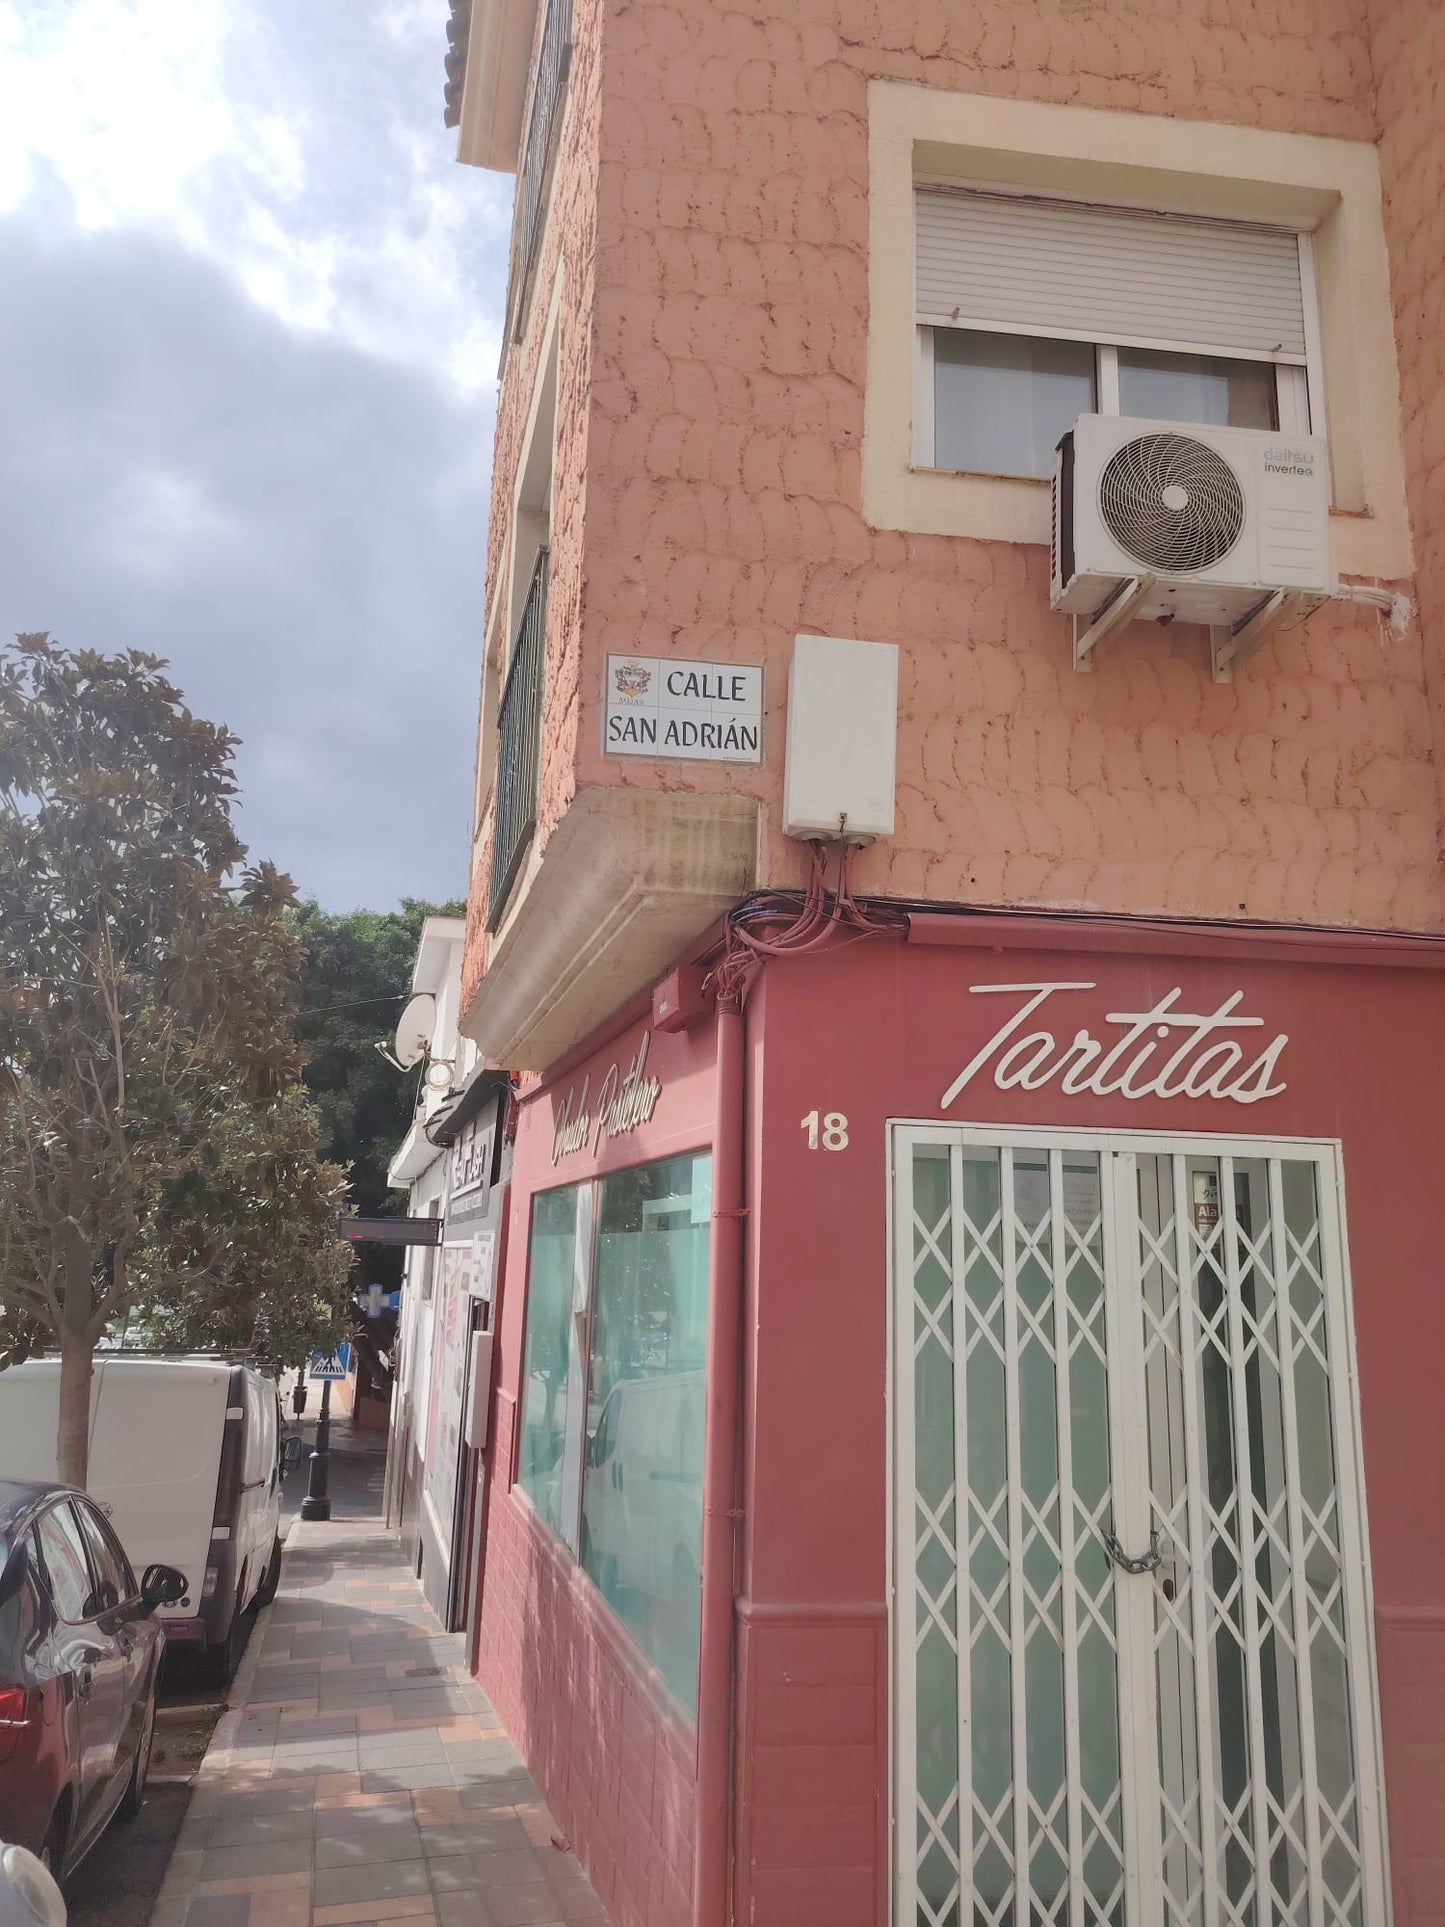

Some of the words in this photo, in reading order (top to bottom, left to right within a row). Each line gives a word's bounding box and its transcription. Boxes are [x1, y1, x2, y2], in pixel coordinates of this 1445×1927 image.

[1263, 447, 1314, 464] daitsu
[667, 671, 747, 701] CALLE
[609, 715, 657, 744] SAN
[664, 718, 758, 750] ADRIÁN
[940, 981, 1289, 1110] Tartitas
[800, 1110, 849, 1151] 18
